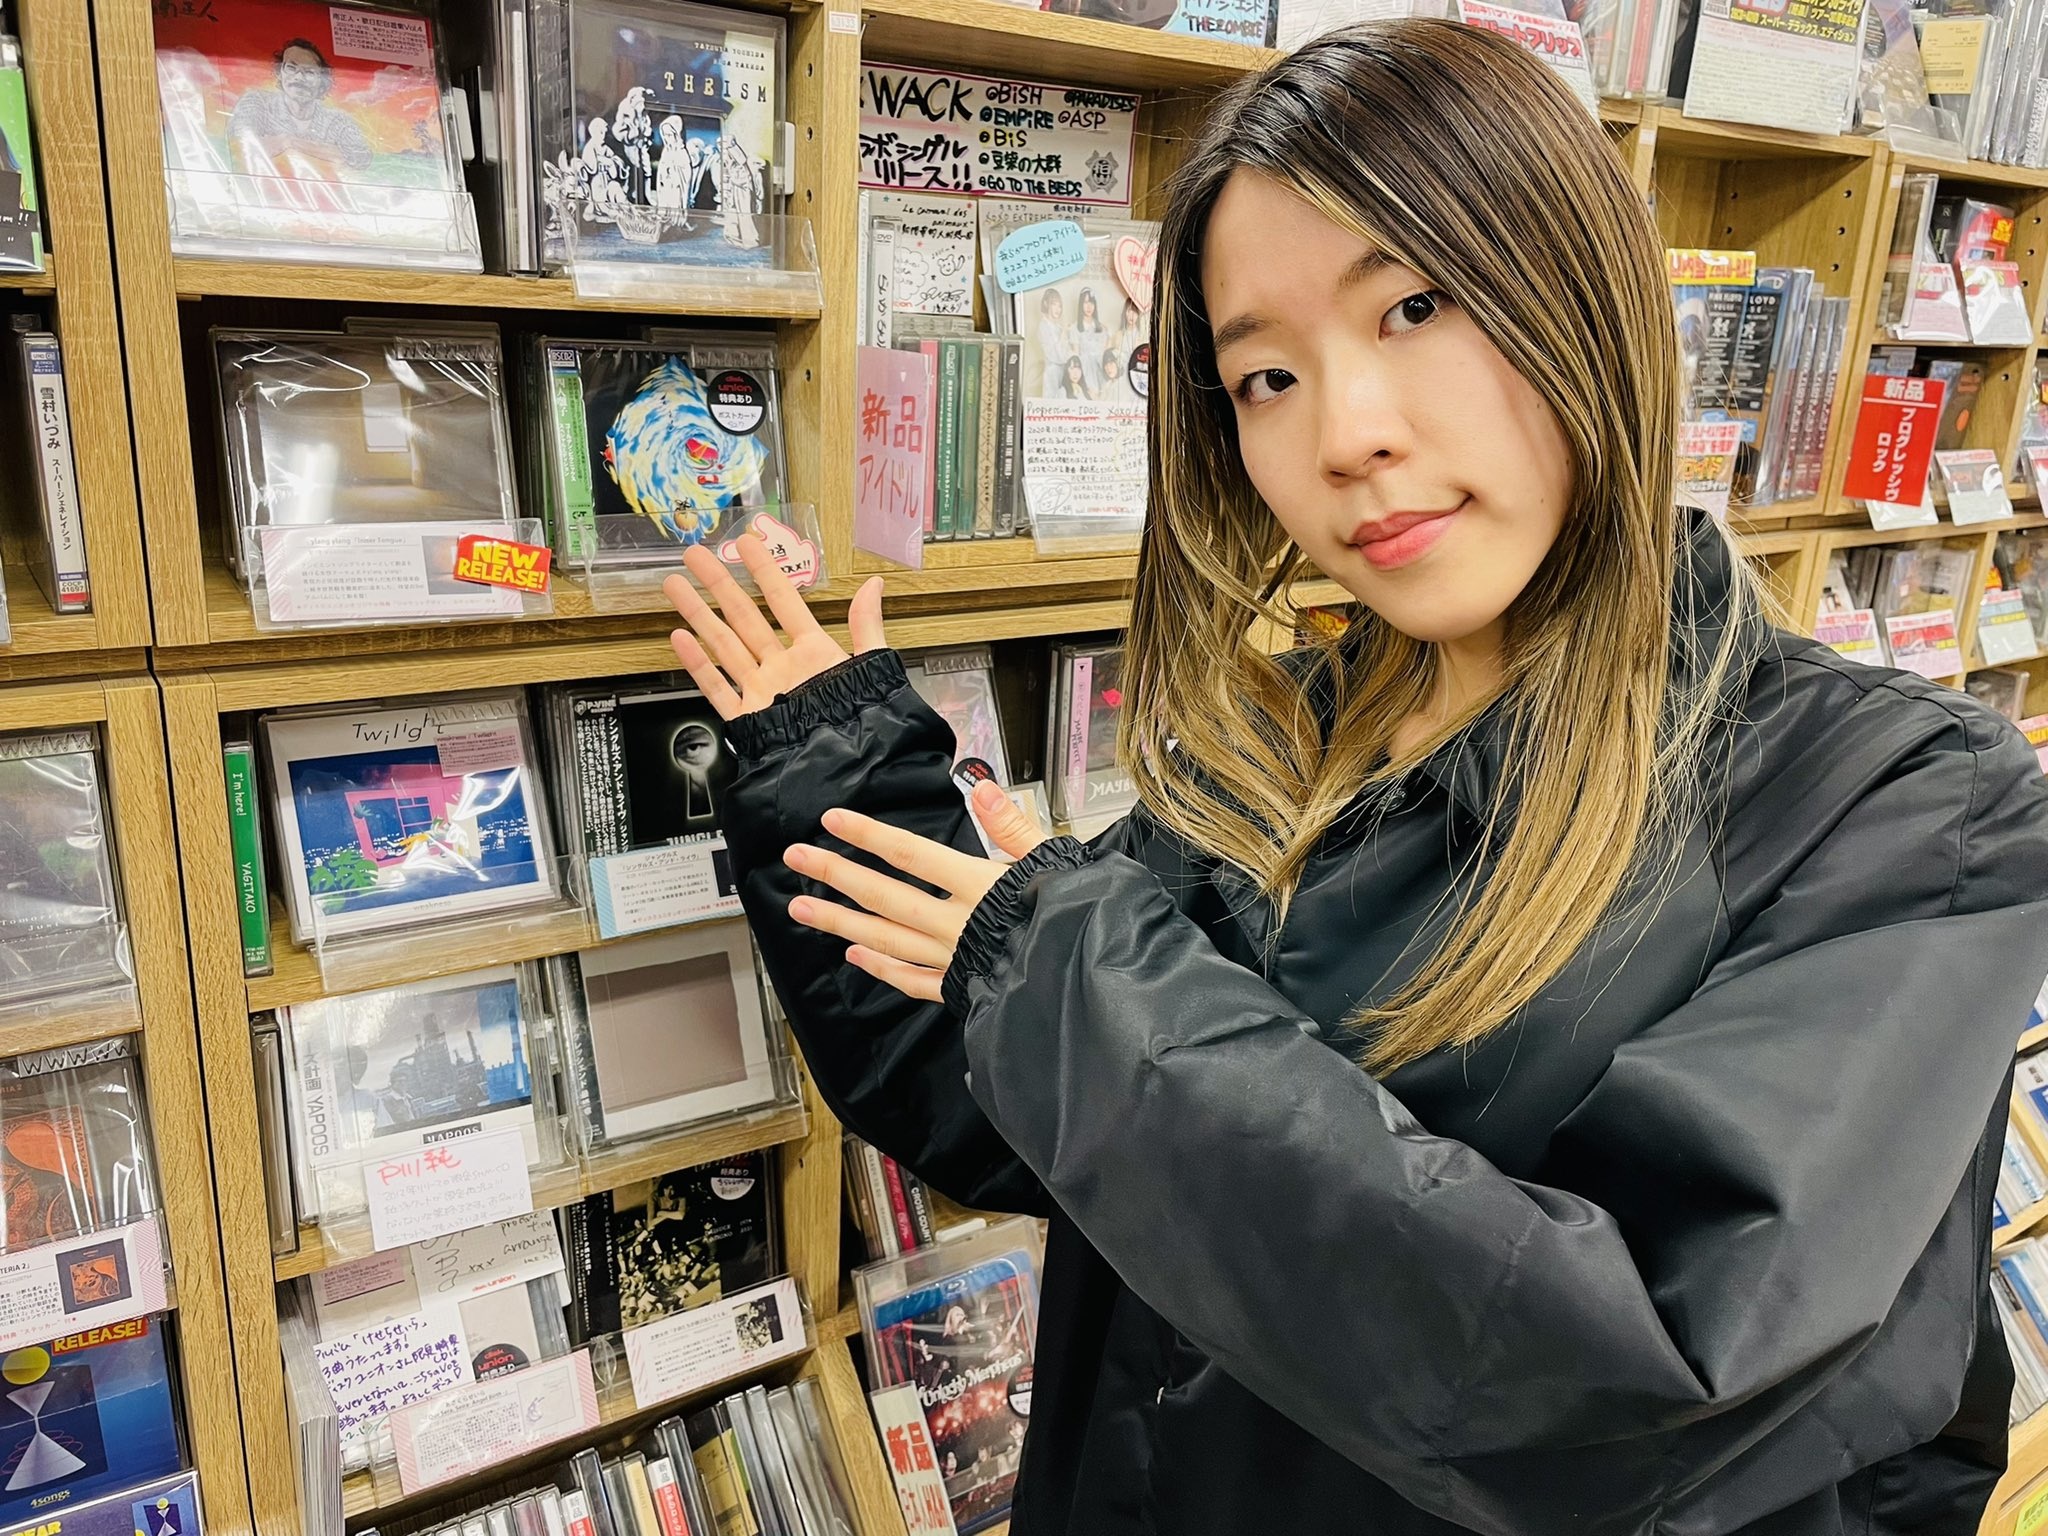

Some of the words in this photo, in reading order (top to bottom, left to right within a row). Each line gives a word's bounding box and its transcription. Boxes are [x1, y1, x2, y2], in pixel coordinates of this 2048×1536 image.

[868, 71, 973, 121] WACK
[998, 85, 1043, 105] BiSH
[1070, 111, 1106, 129] ASP
[994, 130, 1028, 147] BiS
[1009, 178, 1024, 193] TO
[1025, 179, 1047, 195] THE
[1048, 181, 1082, 197] BEDS
[718, 384, 753, 393] union
[719, 393, 753, 404] 特典あり
[1884, 378, 1925, 402] 新品
[40, 386, 61, 450] 雪村いづみ
[862, 387, 923, 454] 新品
[1872, 432, 1893, 474] ロック
[860, 454, 920, 520] アイドル
[472, 542, 541, 570] NEW
[457, 558, 546, 590] RELEASE!
[352, 712, 445, 745] Twilight
[232, 772, 244, 792] I'm
[234, 791, 247, 817] here!
[241, 862, 257, 913] YAGITAKO
[307, 1095, 329, 1157] YAPOOS
[911, 1187, 926, 1215] CROSS
[53, 1320, 143, 1352] RELEASE!
[477, 1353, 514, 1371] union
[30, 1489, 71, 1509] 4songs
